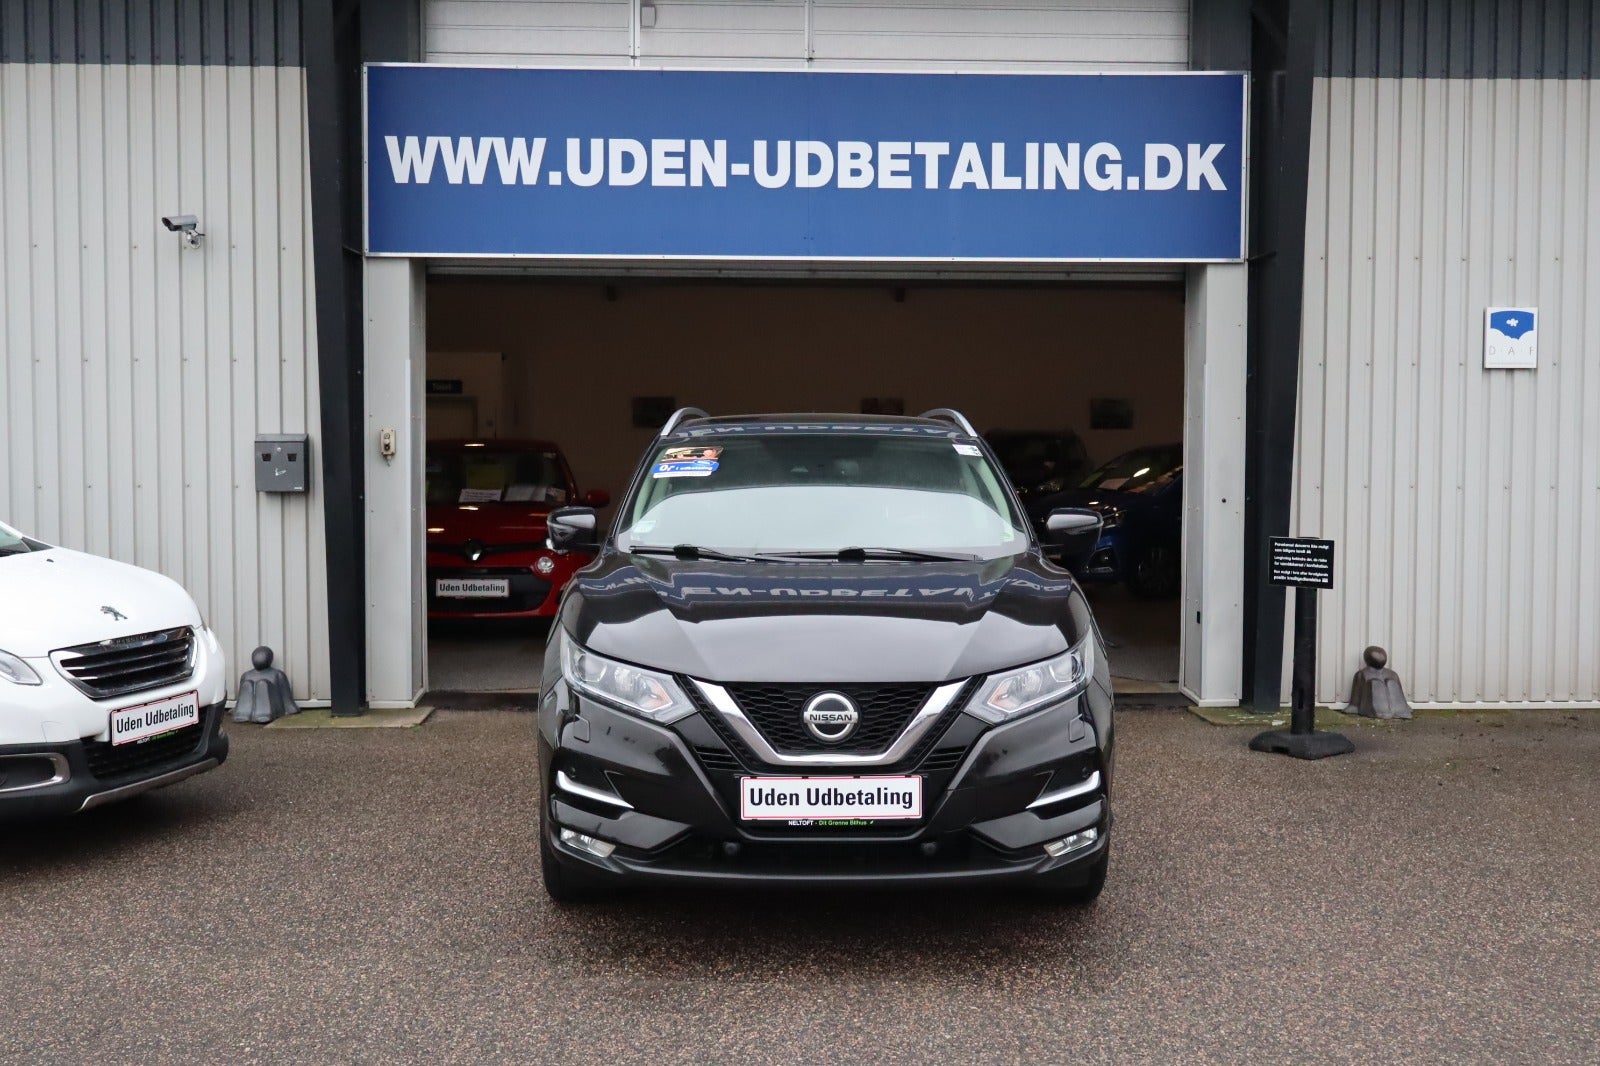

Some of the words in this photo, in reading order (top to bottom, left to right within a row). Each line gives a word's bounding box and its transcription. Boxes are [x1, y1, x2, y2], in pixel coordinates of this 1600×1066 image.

[385, 136, 1227, 191] WWW.UDEN-UDBETALING.DK
[440, 584, 460, 592] Uden
[462, 584, 505, 593] Udbetaling
[116, 717, 142, 733] Uden
[145, 703, 194, 726] Udbetaling
[809, 713, 852, 722] NISSAN
[750, 788, 800, 806] Uden
[806, 787, 913, 809] Udbetaling
